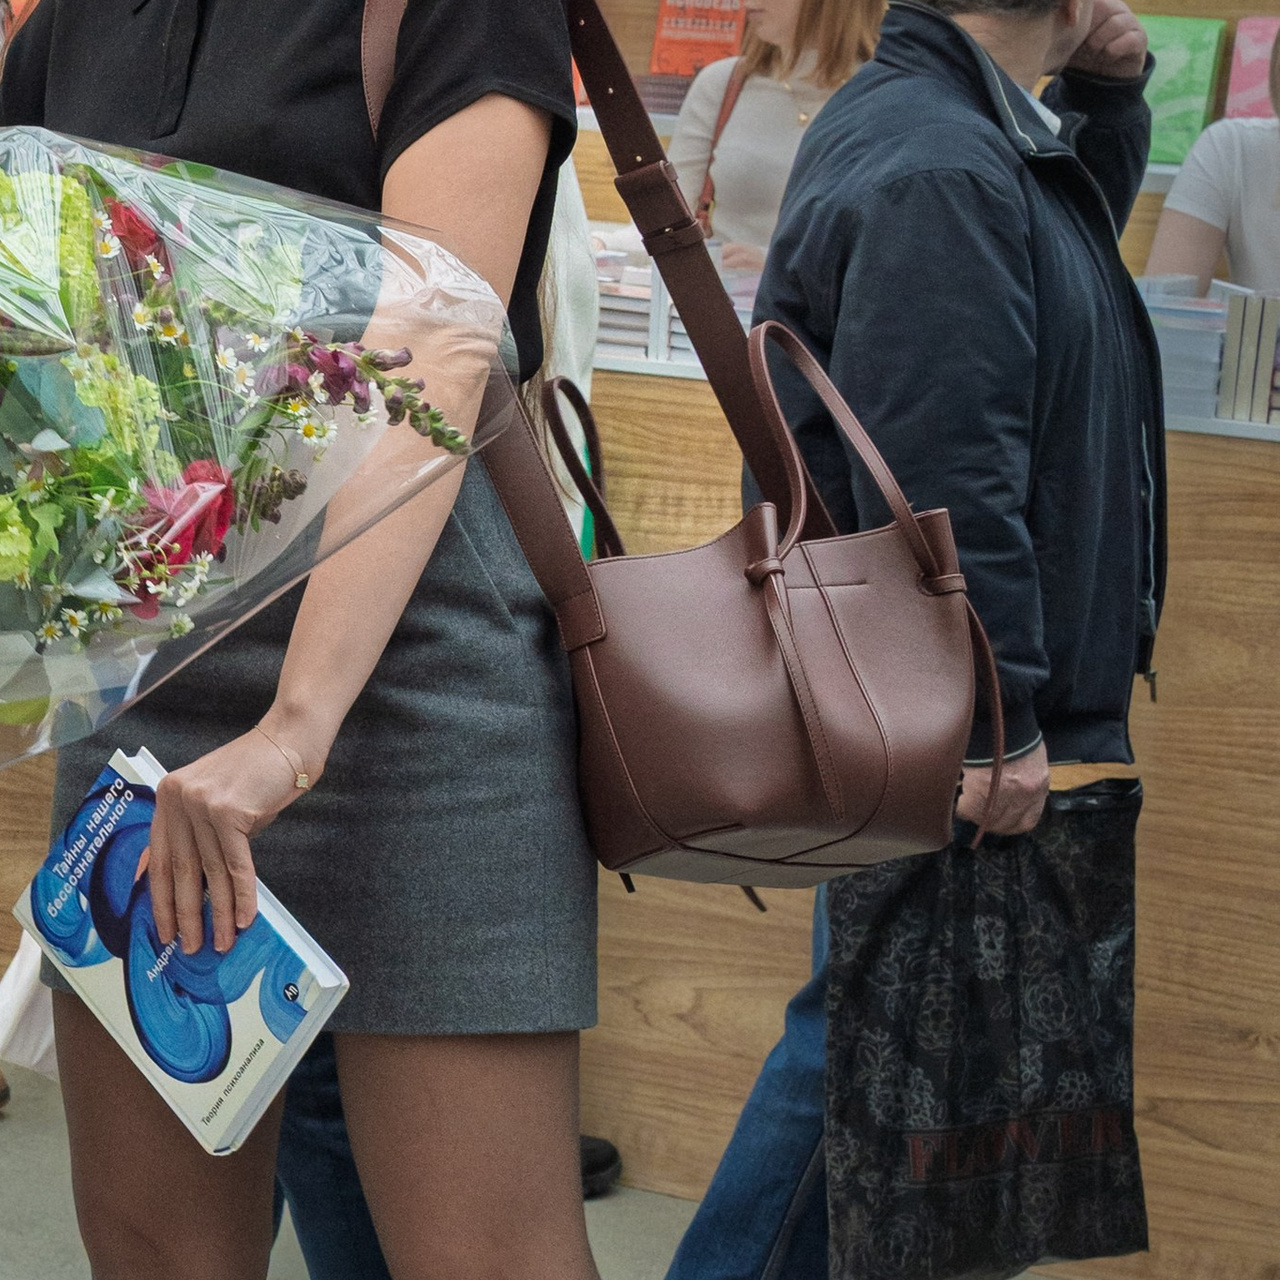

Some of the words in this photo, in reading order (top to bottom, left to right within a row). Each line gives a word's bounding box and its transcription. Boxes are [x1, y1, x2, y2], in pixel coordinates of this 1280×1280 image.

[47, 789, 134, 918] бессознательного
[52, 834, 88, 878] Тайны
[86, 778, 124, 833] нашего
[202, 1096, 224, 1126] Теория
[223, 1038, 265, 1097] психоанализа
